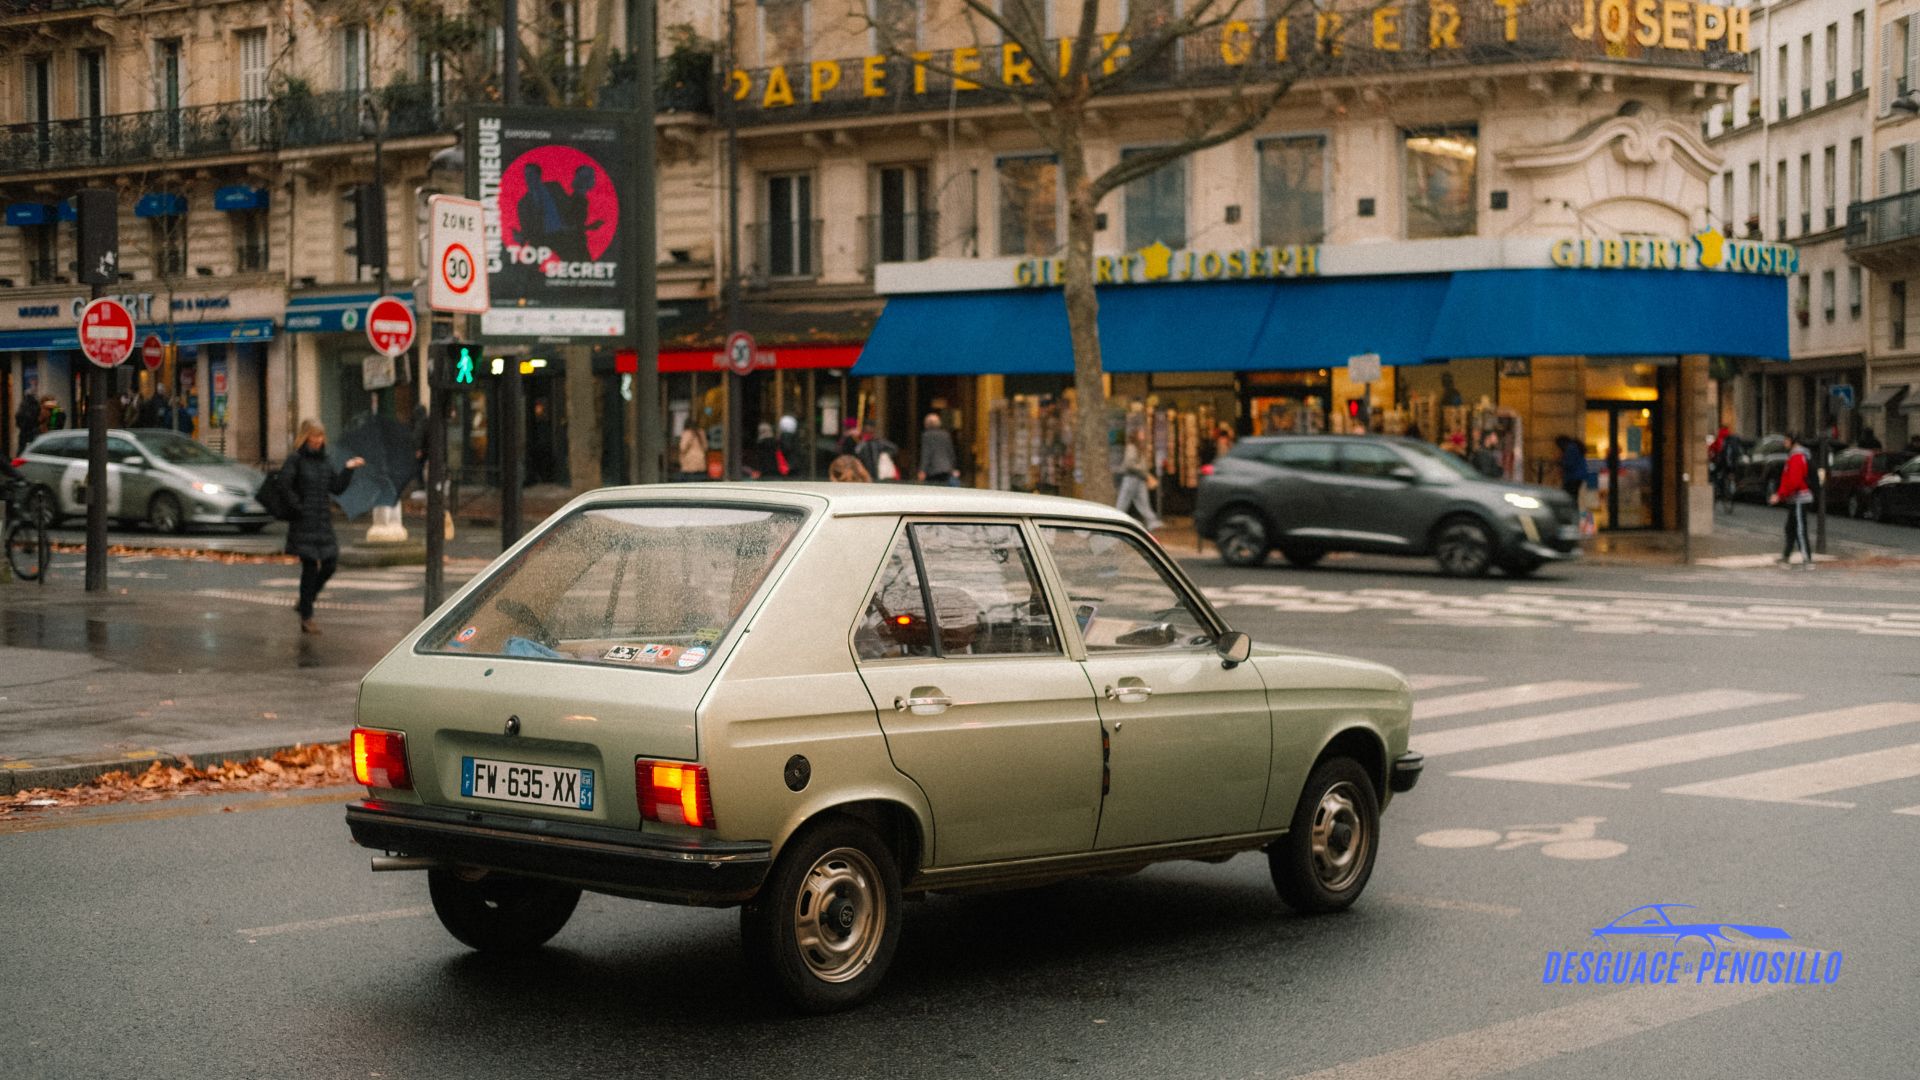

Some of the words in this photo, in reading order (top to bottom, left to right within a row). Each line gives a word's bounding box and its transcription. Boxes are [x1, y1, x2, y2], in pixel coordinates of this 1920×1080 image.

[1571, 0, 1750, 53] JOSEPH
[442, 212, 475, 231] ZONE
[506, 246, 552, 264] TOP
[1180, 245, 1318, 281] JOSEPH
[1550, 238, 1690, 269] GIBERT
[449, 257, 468, 279] 30
[545, 261, 617, 278] SECRET
[580, 789, 593, 806] 51
